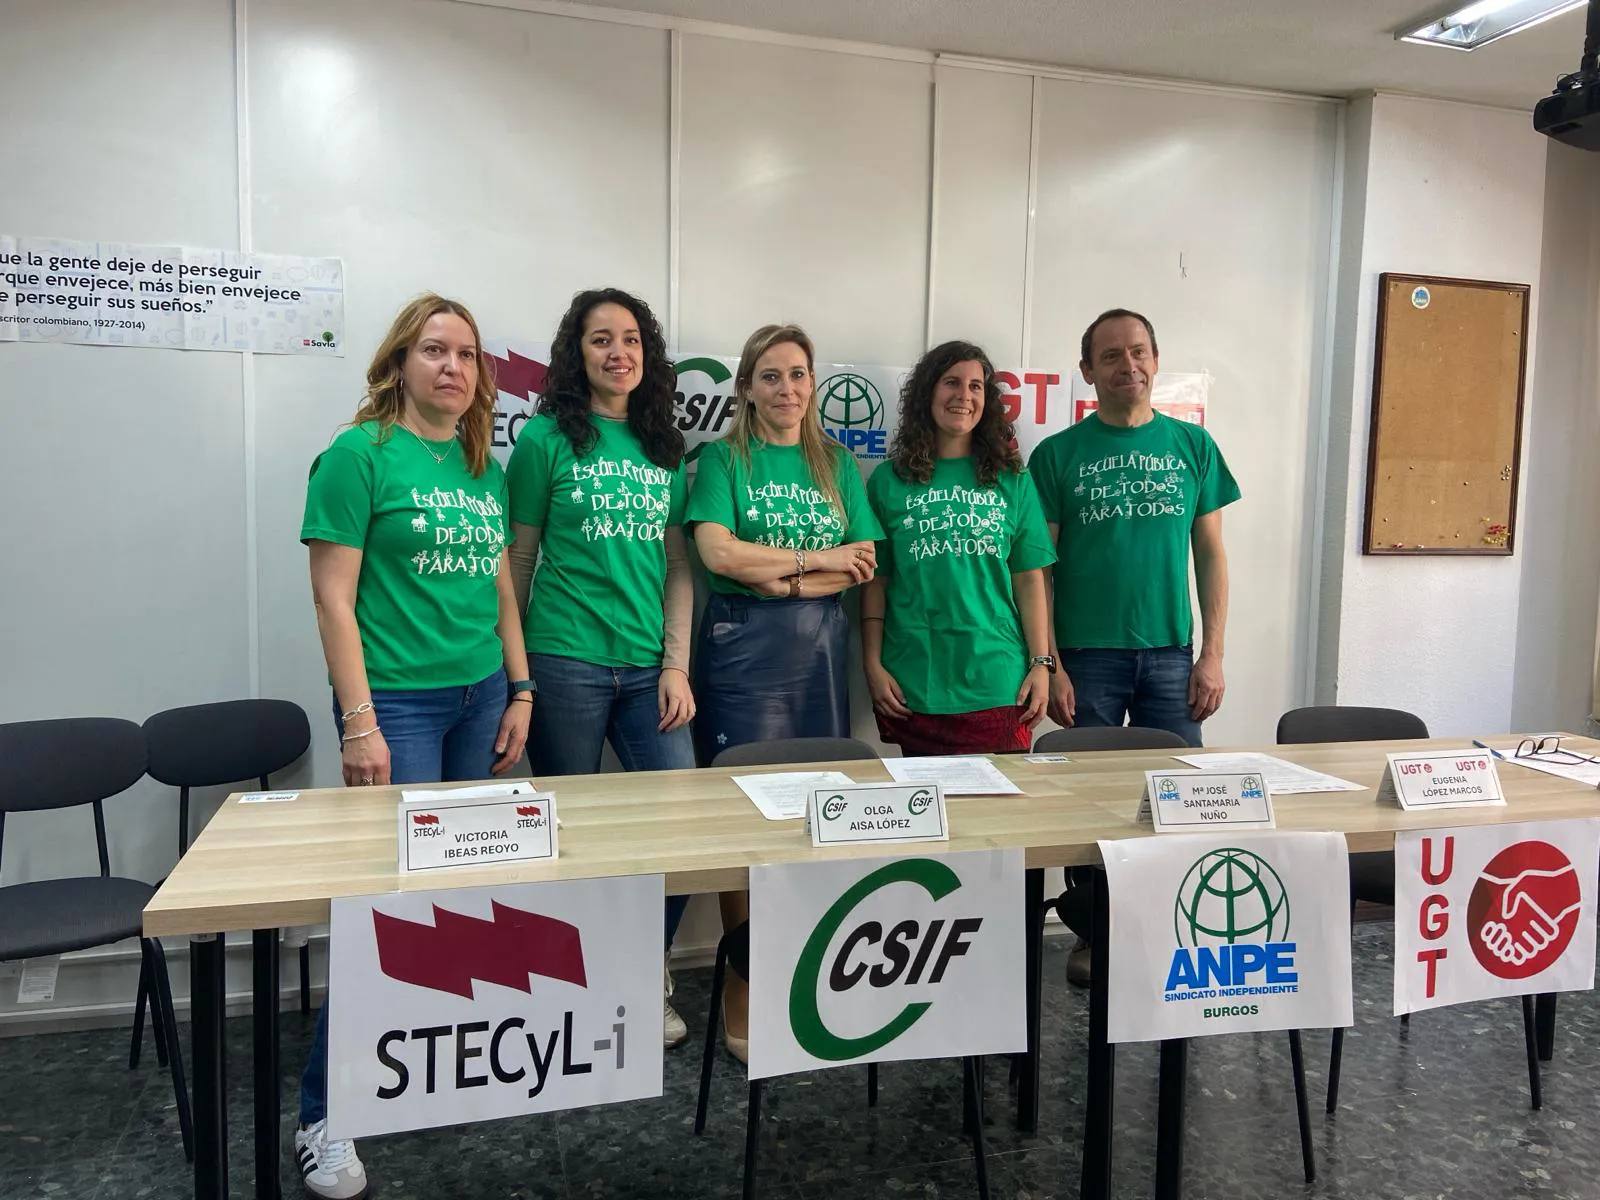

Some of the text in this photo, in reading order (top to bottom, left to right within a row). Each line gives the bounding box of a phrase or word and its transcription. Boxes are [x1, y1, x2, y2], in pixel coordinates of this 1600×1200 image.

[28, 251, 43, 266] la
[50, 256, 100, 271] gente
[107, 257, 146, 275] deje
[151, 259, 173, 274] de
[178, 264, 261, 282] perseguir
[45, 274, 134, 292] envejece,
[139, 278, 173, 293] más
[178, 279, 216, 295] bien
[221, 285, 301, 302] envejece
[15, 292, 101, 309] perseguir
[107, 297, 135, 309] sus
[33, 316, 92, 328] colombiano,
[94, 319, 146, 331] 1927-2014)
[1090, 485, 1116, 500] DE
[591, 494, 619, 511] DE
[765, 513, 788, 528] DE
[1081, 504, 1123, 524] PARA
[919, 516, 943, 533] DE
[435, 527, 460, 544] DE
[1400, 764, 1422, 775] UGT
[1456, 760, 1478, 771] UGT
[1432, 775, 1468, 785] EUGENIA
[1159, 792, 1181, 800] ANPE
[1205, 785, 1228, 795] JOSÉ
[1241, 789, 1263, 799] ANPE
[1422, 785, 1483, 797] LÓPEZ MARCOS
[827, 802, 849, 813] CSIF
[912, 797, 934, 807] CSIF
[1183, 798, 1241, 808] SANTAMARIA
[864, 805, 894, 816] OLGA
[1200, 809, 1228, 820] NUÑO
[517, 818, 547, 829] STECyL-i
[849, 817, 911, 831] AISA LÓPEZ
[413, 827, 445, 838] STECyL-i
[454, 830, 508, 843] VICTORIA
[444, 843, 519, 859] IBEAS REOYO
[1417, 836, 1454, 998] UGT
[829, 917, 984, 992] CSIF
[1164, 942, 1298, 991] ANPE
[1164, 985, 1298, 1002] SINDICATO INDEPENDIENTE
[1203, 1005, 1259, 1018] BURGOS
[376, 1005, 626, 1100] STECyL-i
